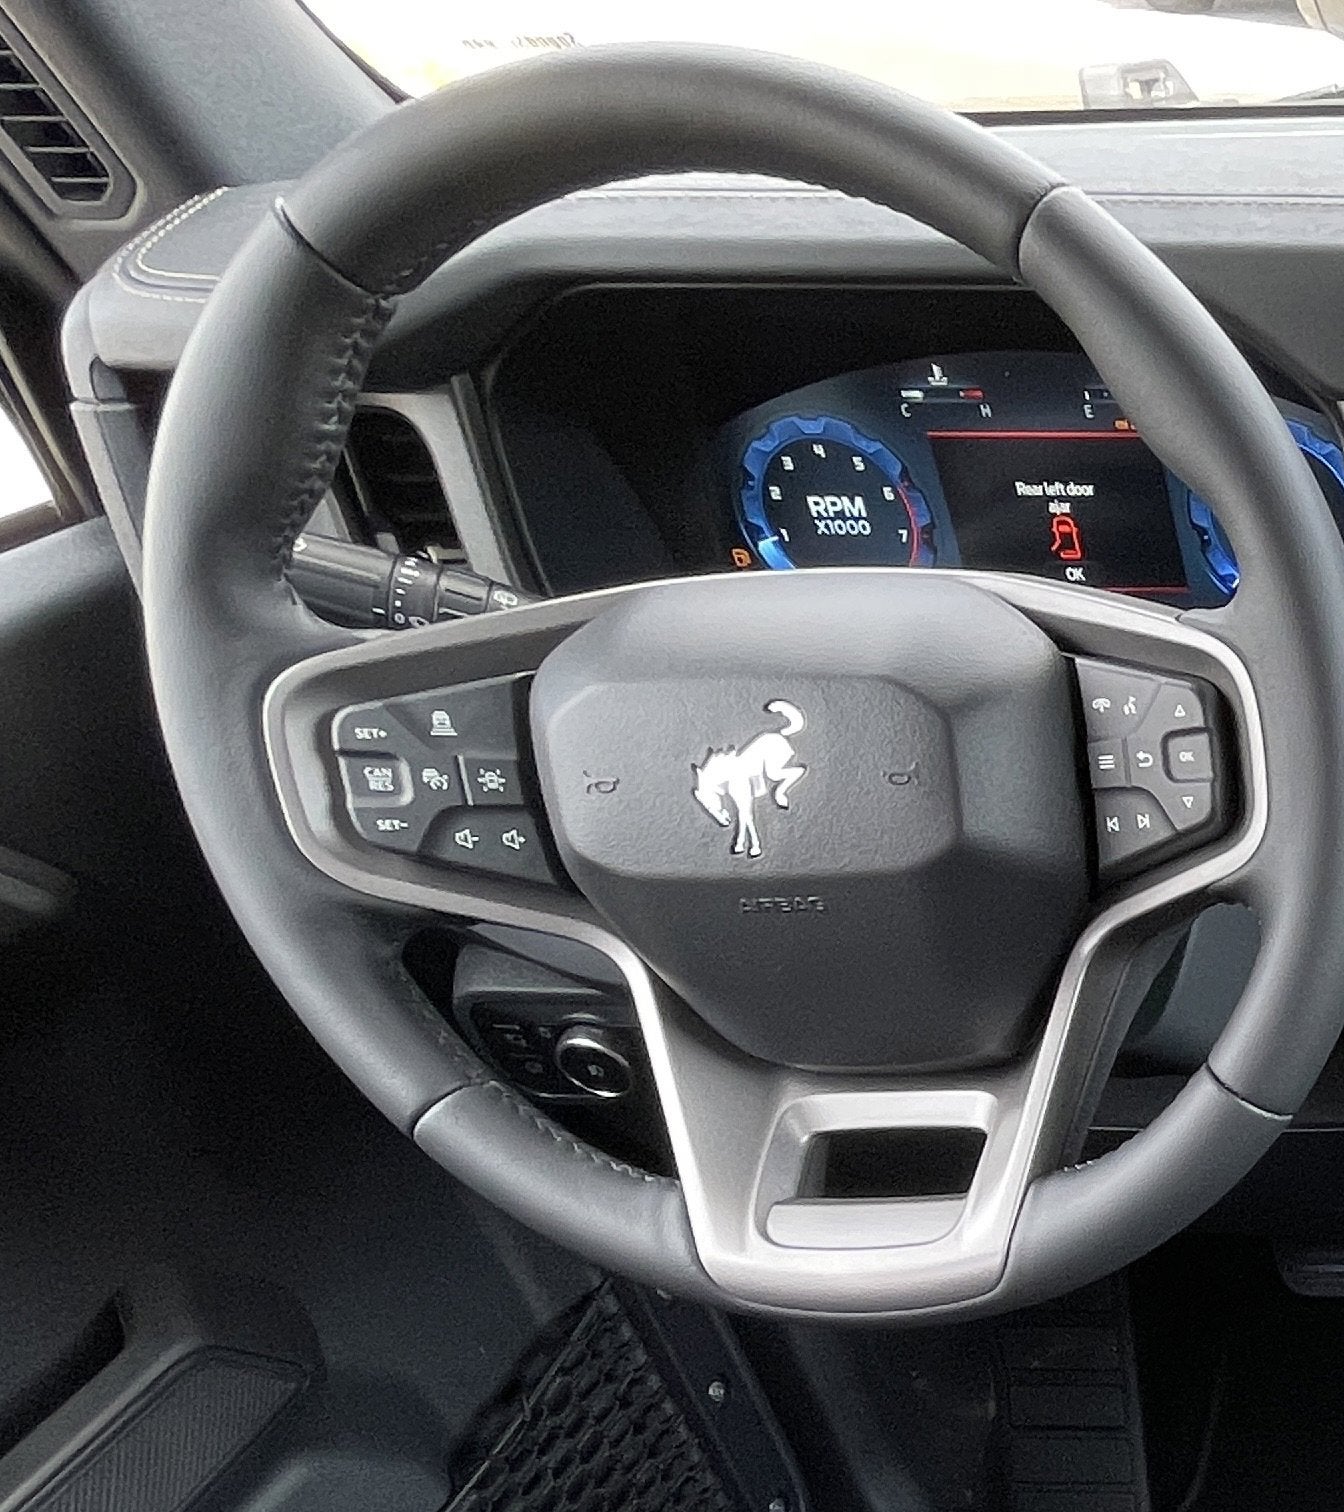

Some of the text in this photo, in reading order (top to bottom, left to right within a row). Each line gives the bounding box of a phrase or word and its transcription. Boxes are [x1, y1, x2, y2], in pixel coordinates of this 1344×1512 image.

[900, 403, 911, 418] C
[979, 404, 992, 418] H
[1083, 404, 1094, 418] E
[812, 444, 826, 458] 4
[780, 456, 794, 470] 3
[852, 456, 865, 471] 5
[769, 486, 782, 500] 2
[882, 486, 895, 500] 6
[1014, 481, 1094, 496] Rear left door
[806, 495, 867, 518] RPM
[779, 527, 790, 542] 1
[813, 519, 871, 536] X1000
[898, 529, 908, 543] 7
[1064, 567, 1086, 581] OK
[1179, 751, 1195, 763] OK
